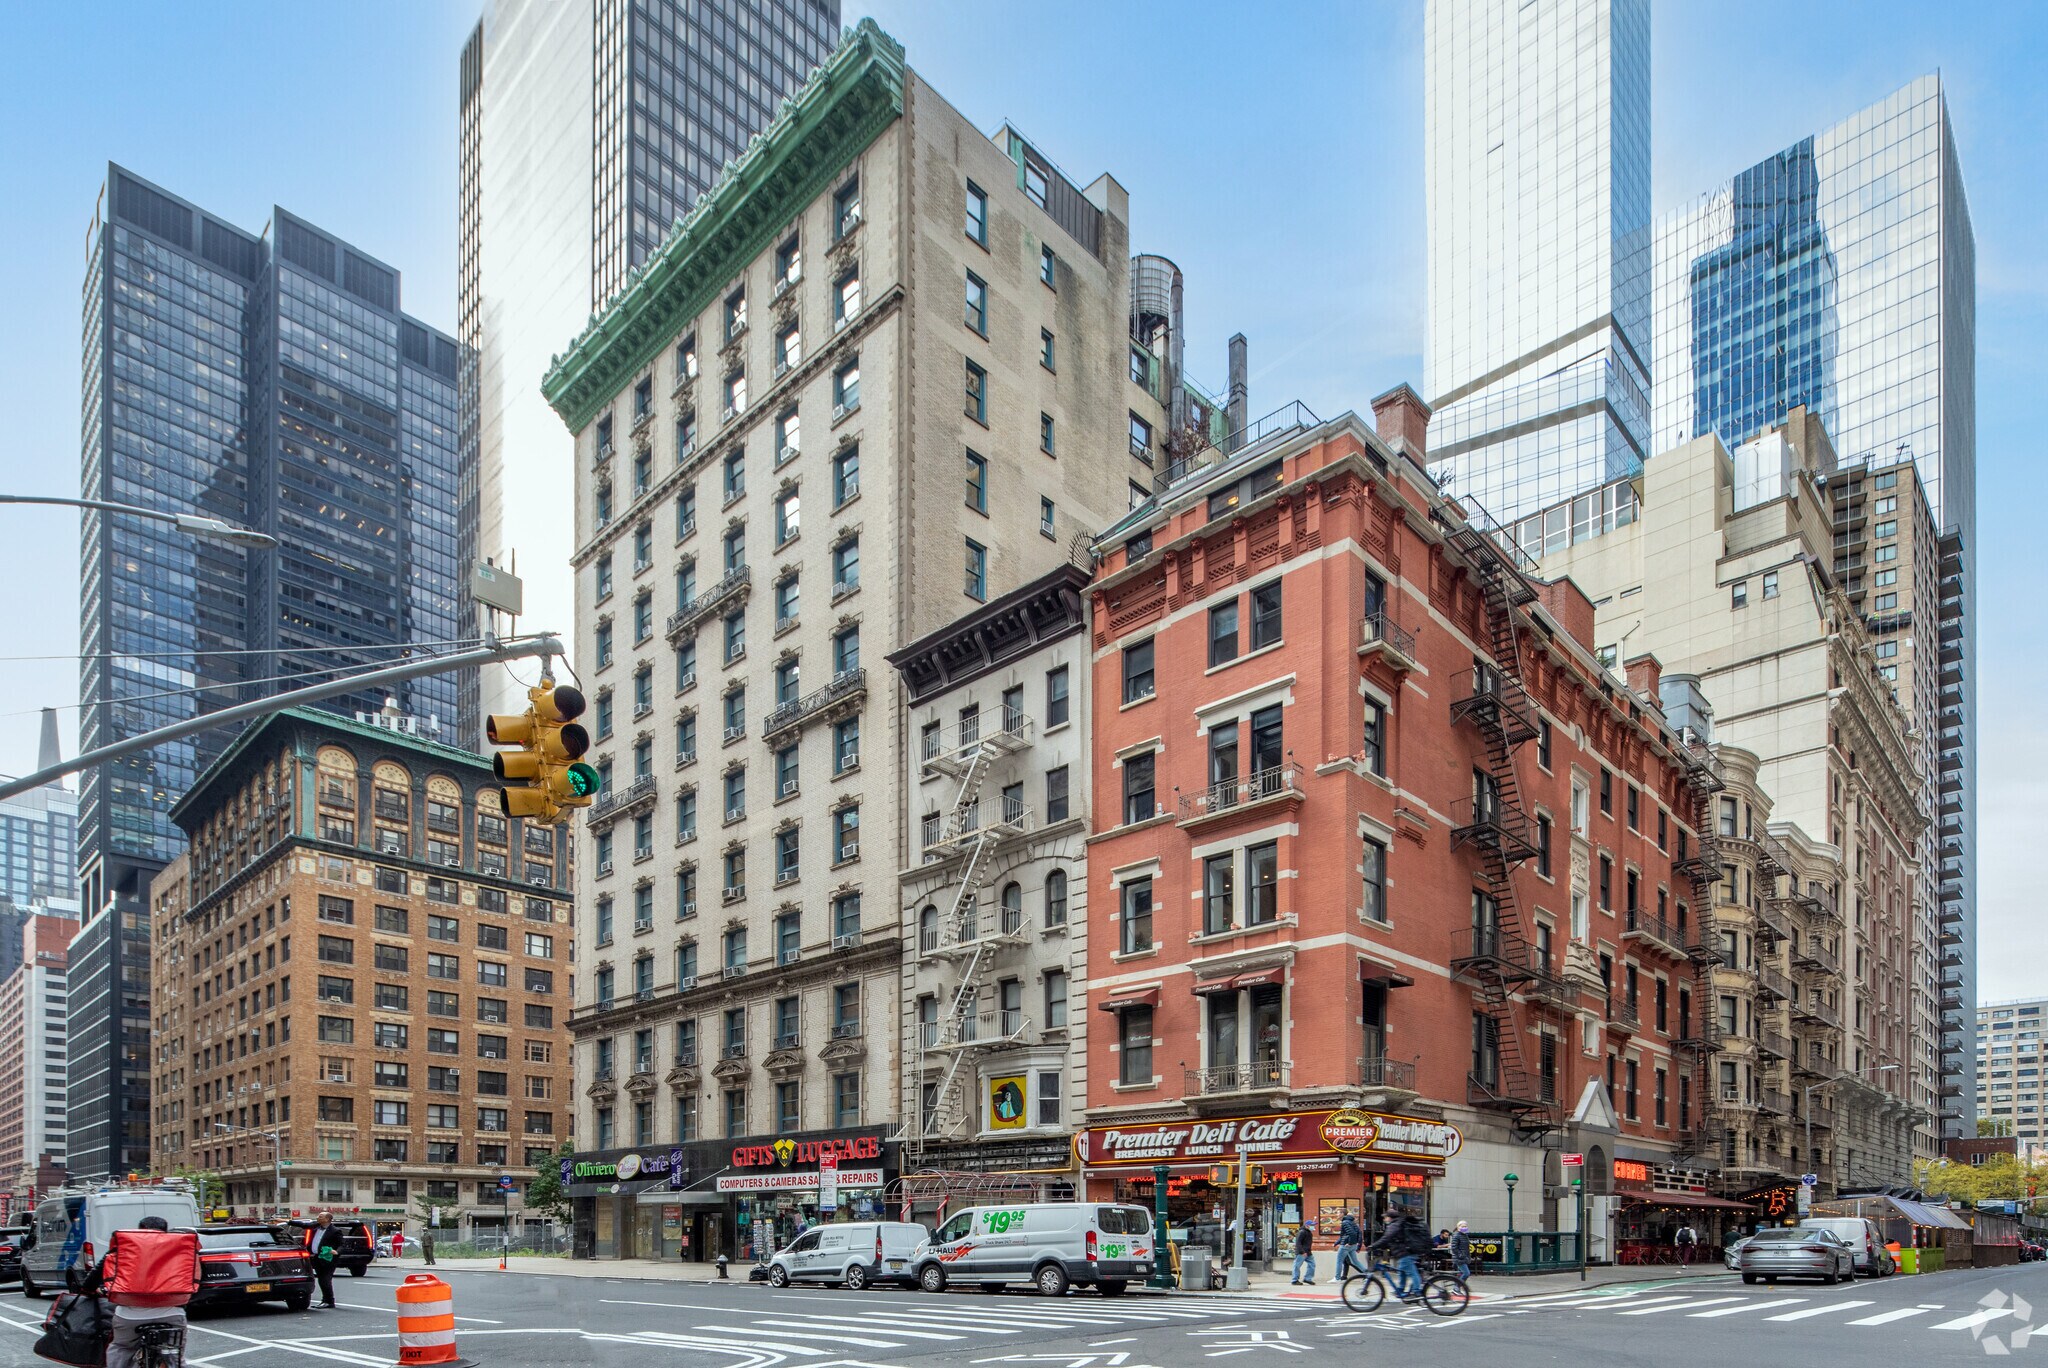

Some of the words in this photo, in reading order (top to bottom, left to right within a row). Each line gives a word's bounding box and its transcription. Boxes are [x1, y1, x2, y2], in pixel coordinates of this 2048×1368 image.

[1102, 1126, 1189, 1150] Premier
[1190, 1122, 1237, 1144] Deli
[1239, 1118, 1299, 1142] Café
[1325, 1127, 1373, 1136] PREMIER
[1114, 1148, 1177, 1159] BREAKFAST
[1184, 1145, 1224, 1156] LUNCH
[1235, 1141, 1283, 1153] DINNER
[1333, 1135, 1366, 1148] Café
[732, 1145, 774, 1167] GIFTS
[781, 1149, 788, 1160] &
[797, 1136, 879, 1163] LUGGAGE
[575, 1161, 617, 1177] Oliviero
[641, 1155, 669, 1174] Café
[1614, 1160, 1646, 1181] CORNER
[720, 1179, 763, 1189] COMPUTERS
[764, 1178, 770, 1187] &
[770, 1176, 807, 1186] CAMERAS
[841, 1172, 879, 1184] REPAIRS
[1278, 1183, 1297, 1191] ATM
[406, 1350, 422, 1358] DOT
